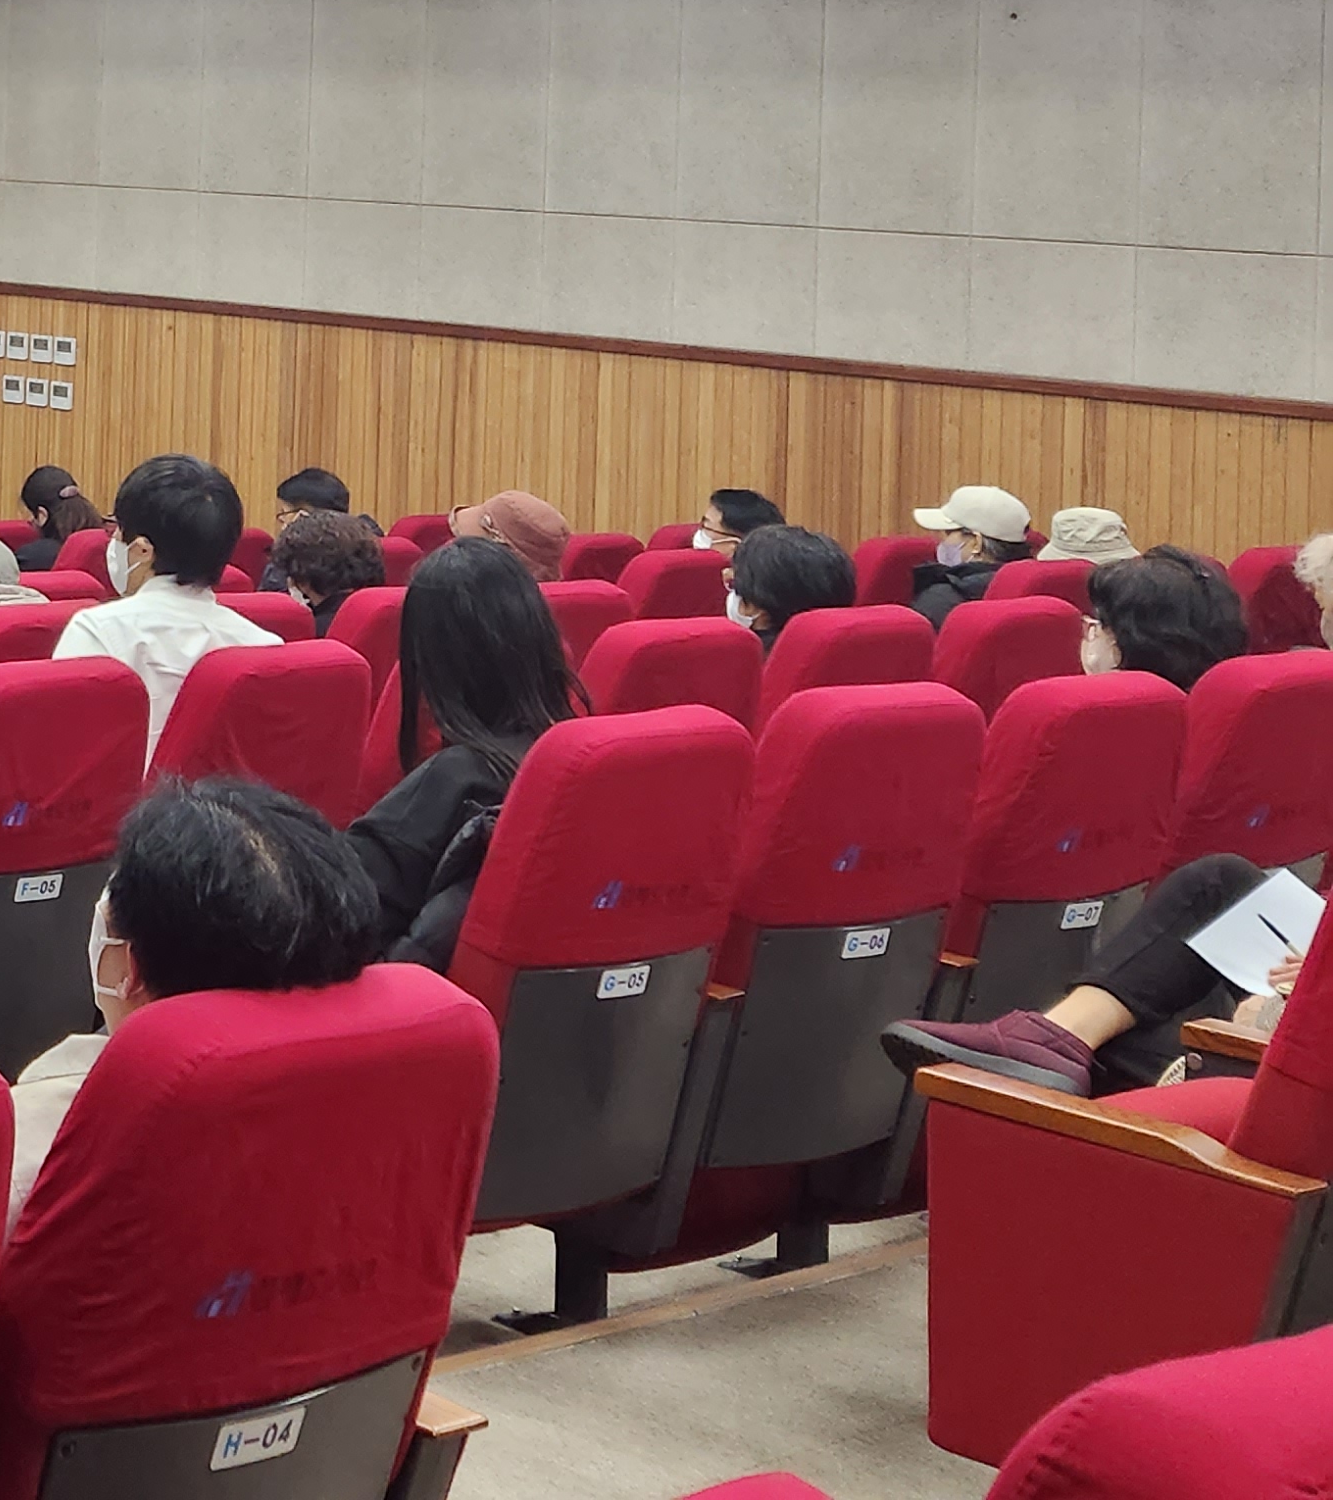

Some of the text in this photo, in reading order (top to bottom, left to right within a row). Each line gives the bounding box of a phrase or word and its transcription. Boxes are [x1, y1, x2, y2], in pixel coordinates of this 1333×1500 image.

[21, 879, 57, 896] F-05
[1066, 905, 1100, 924] G-07
[604, 971, 645, 992] G-05
[223, 1418, 294, 1459] H-04
